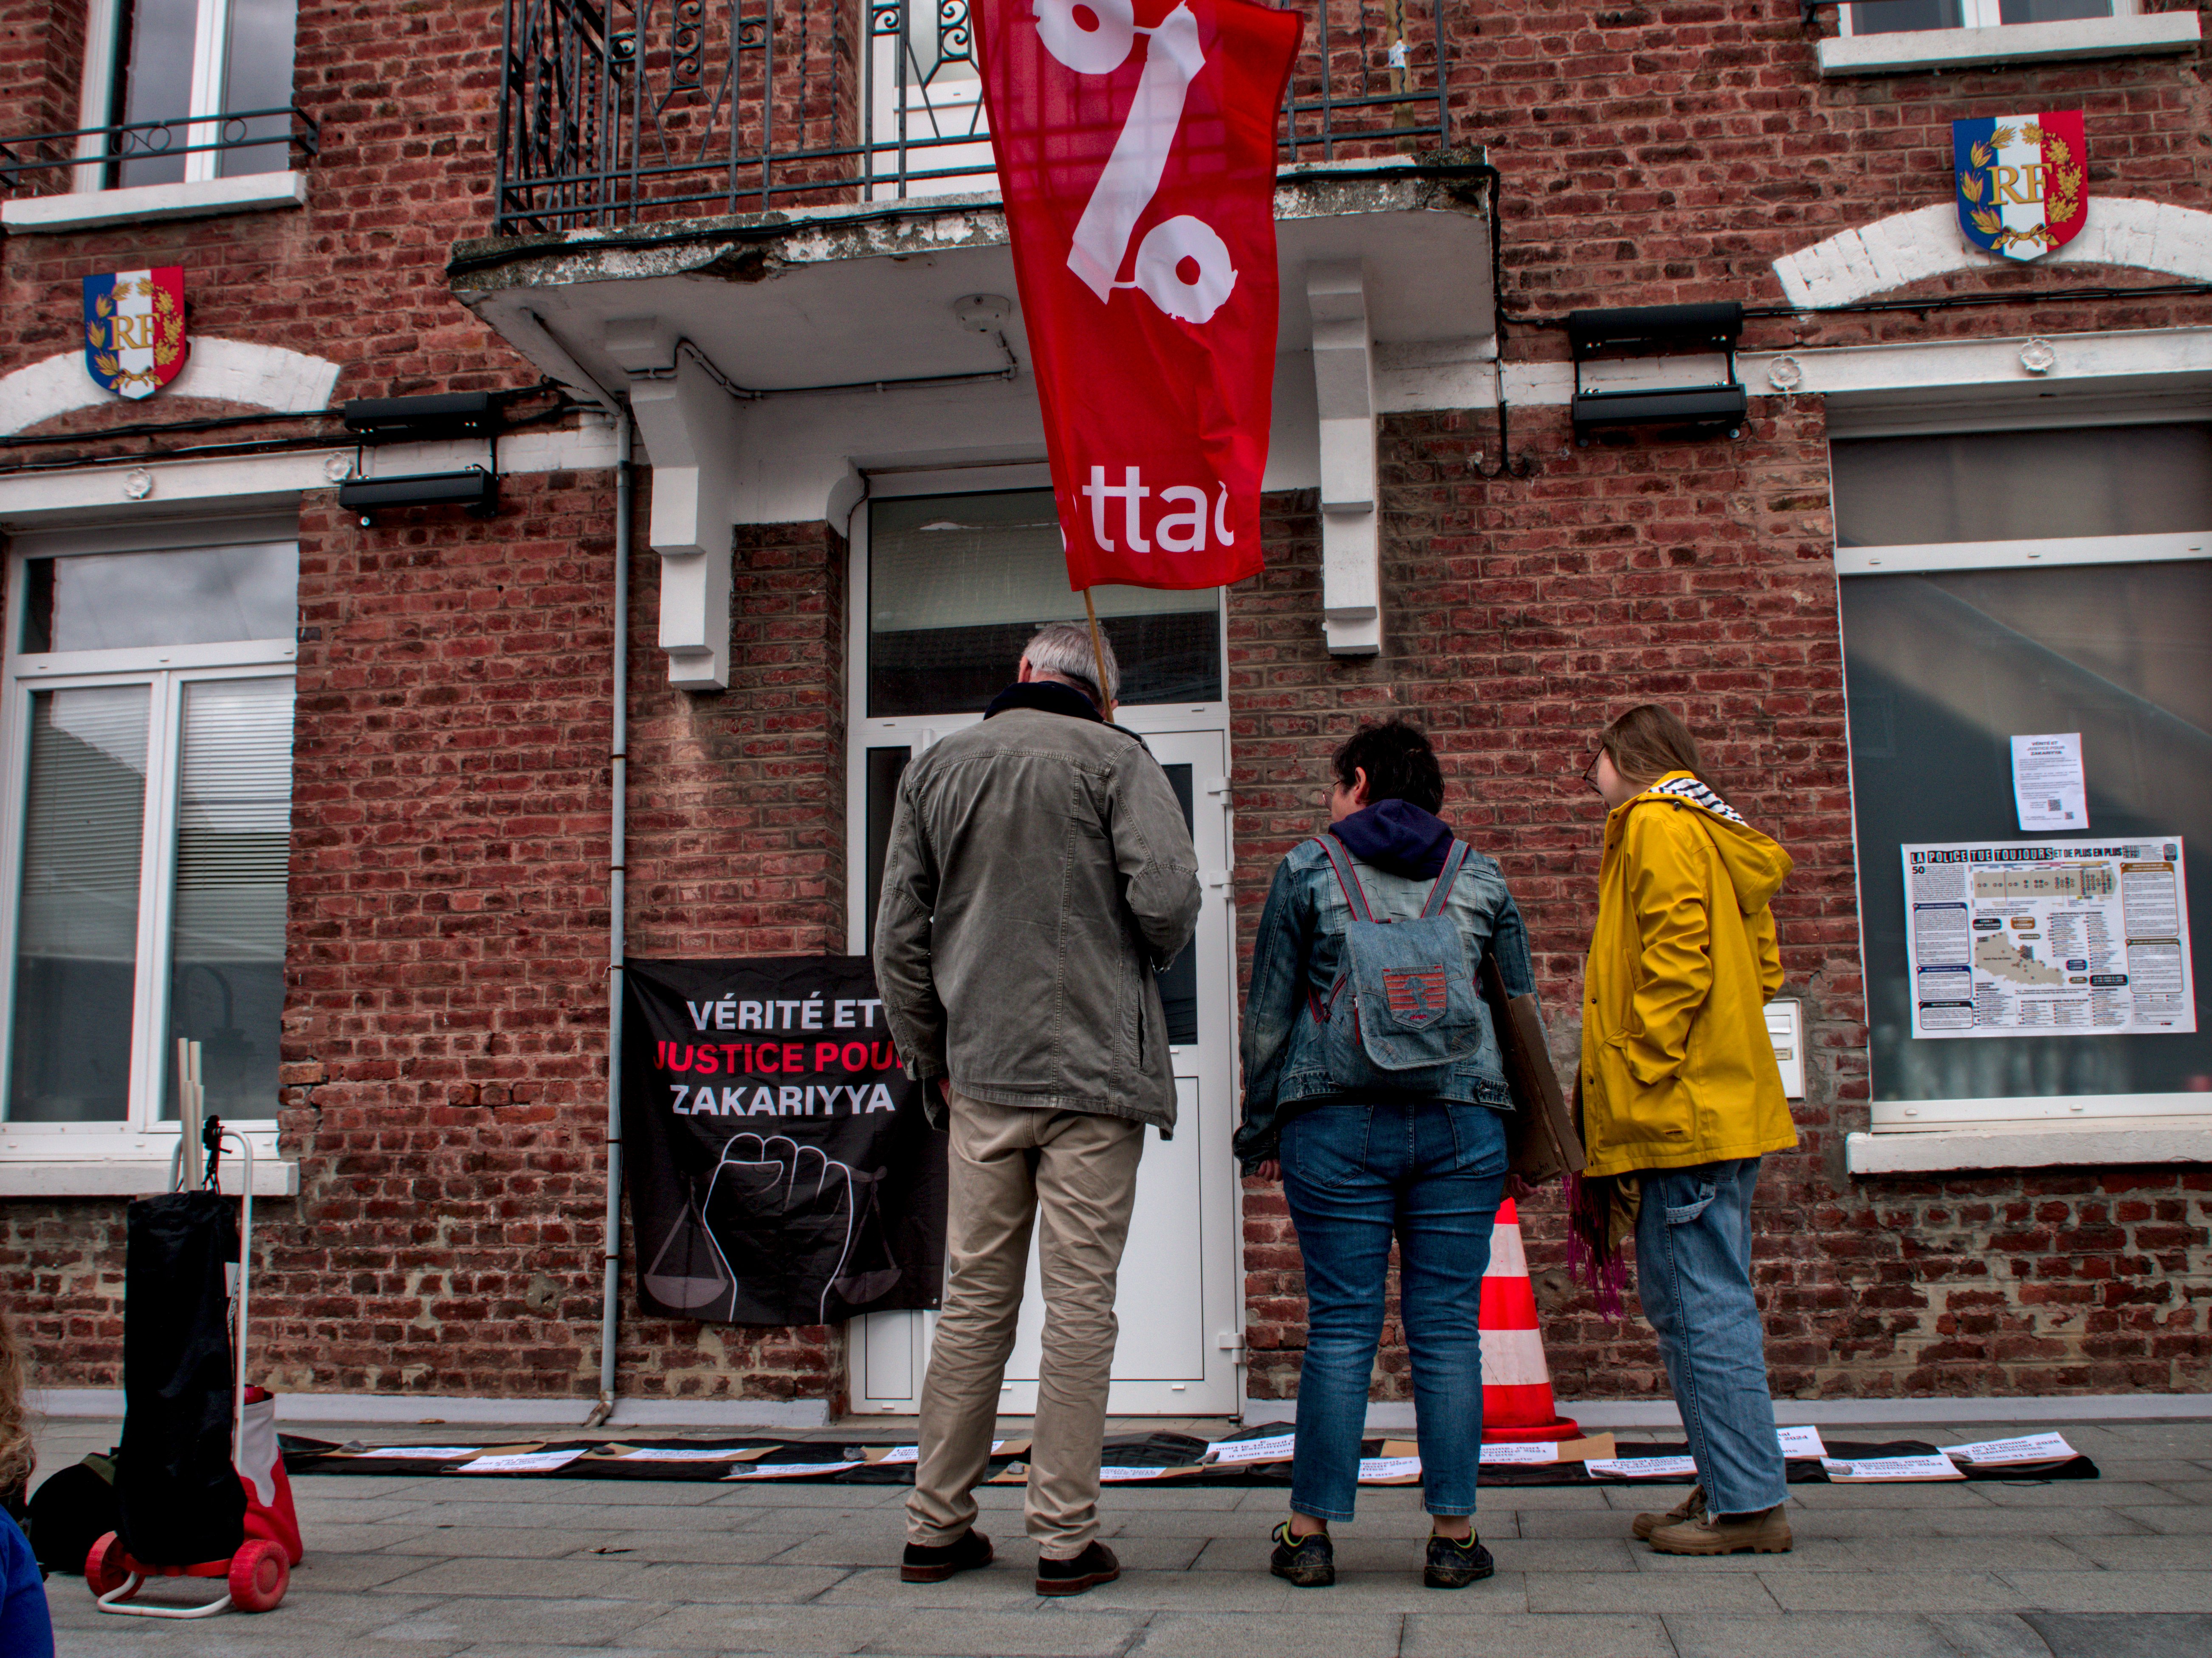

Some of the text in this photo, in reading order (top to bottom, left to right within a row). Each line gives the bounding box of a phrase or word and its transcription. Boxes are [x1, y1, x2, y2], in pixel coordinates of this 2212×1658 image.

[1986, 163, 2054, 206] RF
[108, 313, 160, 351] RF
[1079, 465, 1234, 553] ttac
[1911, 853, 1924, 864] LA
[1928, 850, 1967, 863] POLICE
[1971, 850, 1992, 861] TUE
[1995, 849, 2053, 861] TOUJOURS
[2074, 849, 2092, 857] PLUS
[2093, 849, 2103, 857] EN
[2104, 848, 2122, 857] PLUS
[1912, 866, 1925, 874] 50
[687, 992, 881, 1030] VÉRITÉ ET
[653, 1041, 903, 1074] JUSTICE POU
[669, 1083, 895, 1116] ZAKARIYYA
